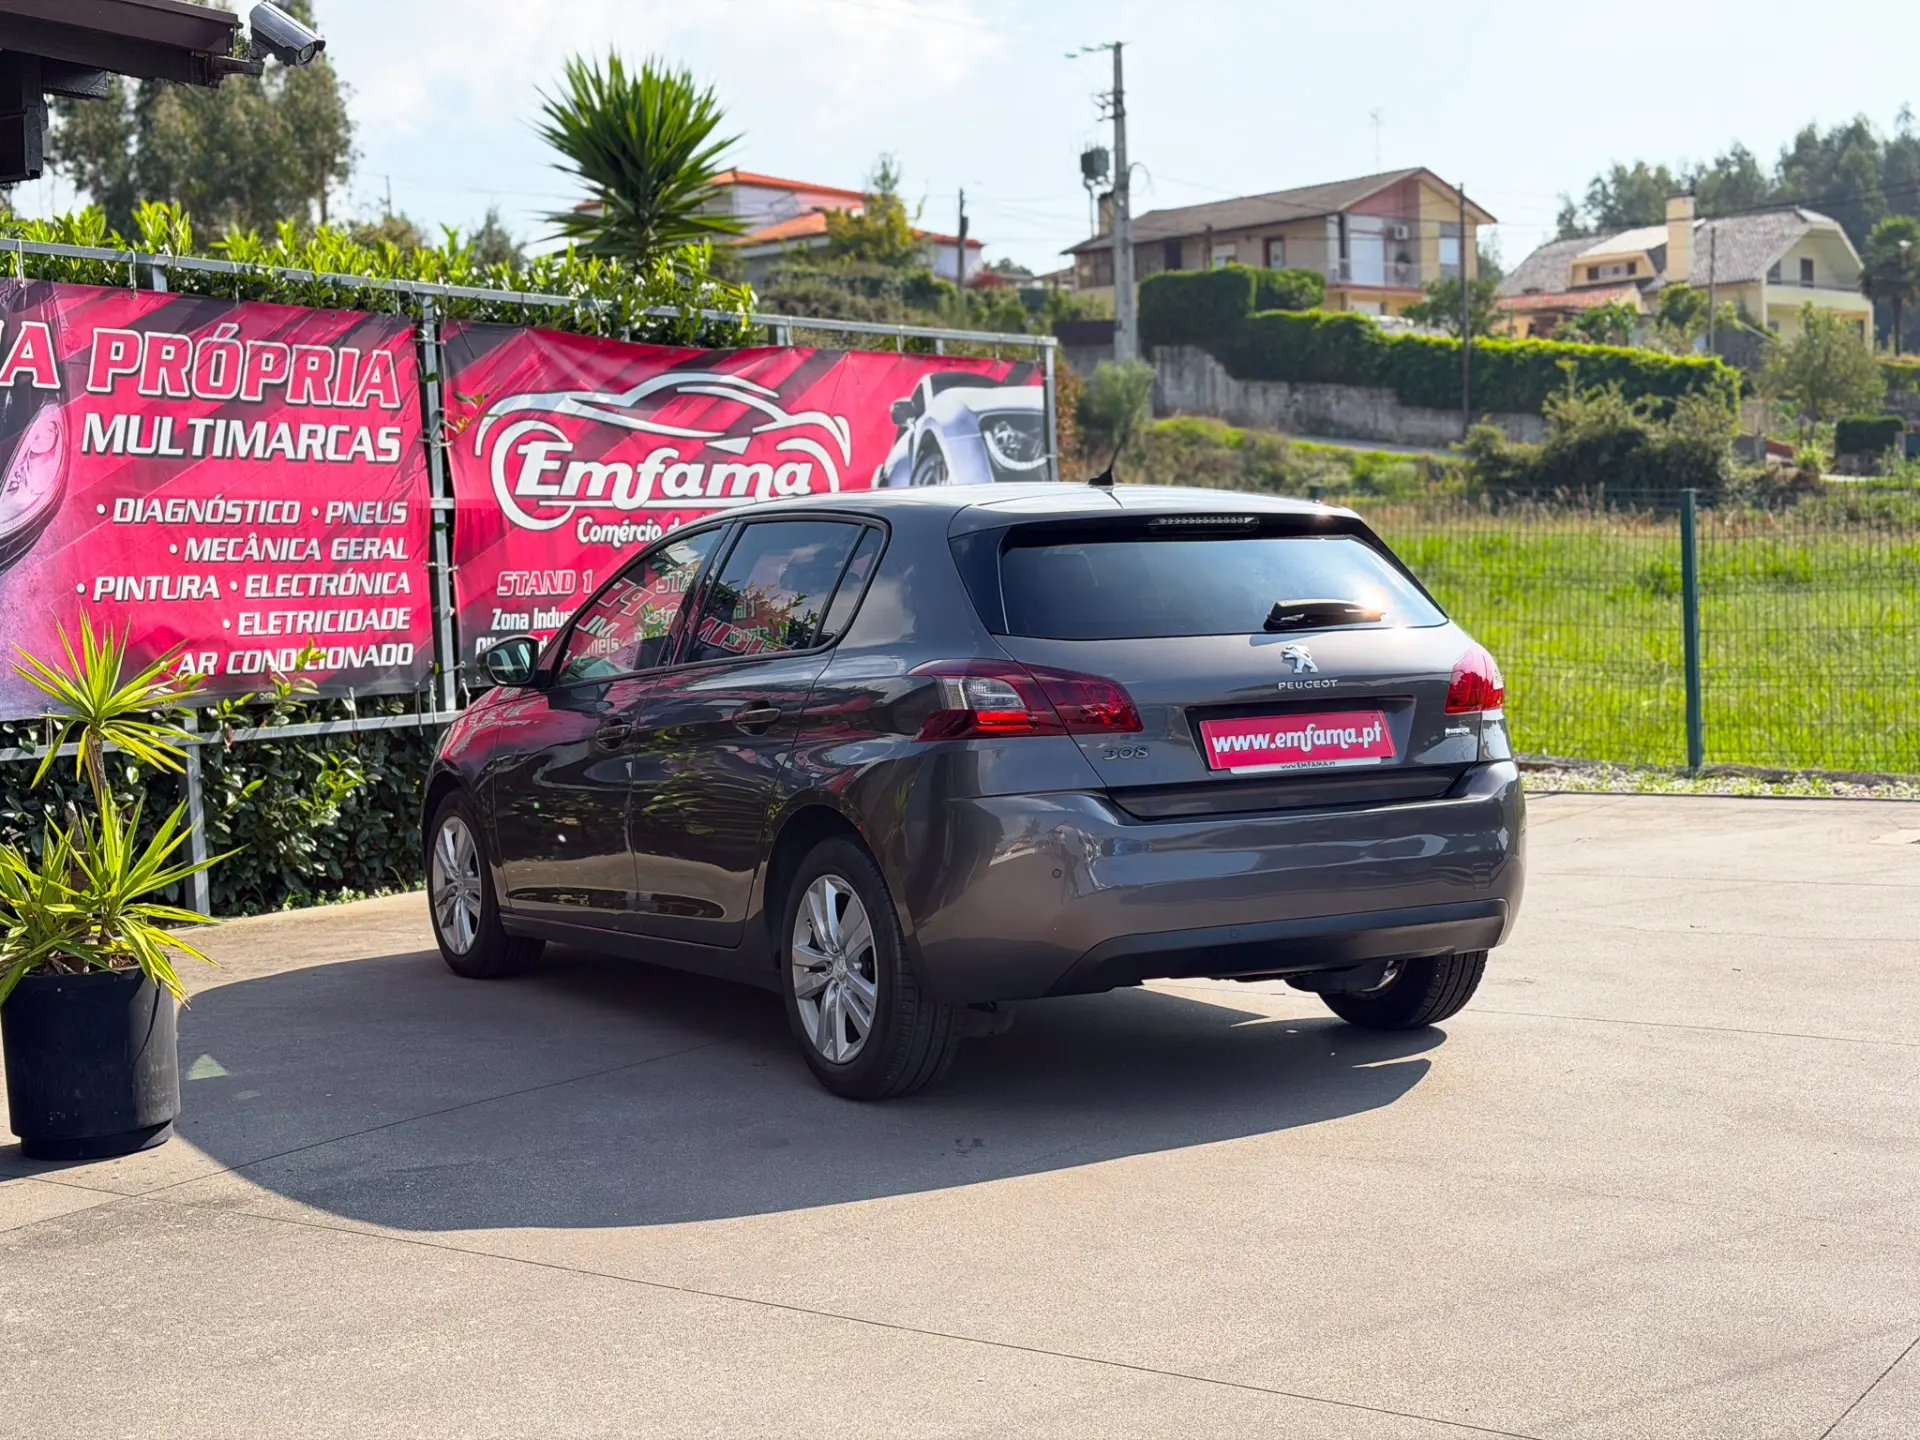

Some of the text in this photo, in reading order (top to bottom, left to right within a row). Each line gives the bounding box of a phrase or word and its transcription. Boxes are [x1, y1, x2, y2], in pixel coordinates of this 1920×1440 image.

[0, 319, 401, 408] A PRÓPRIA
[81, 413, 402, 462] MULTIMARCAS
[514, 440, 813, 511] Emfama
[113, 494, 408, 524] DIAGNÓSTICO PNEUS
[184, 532, 410, 562] MECÂNICA GERAL
[577, 516, 662, 548] Comércio
[93, 570, 411, 601] PINTURA ELECTRÓNICA
[497, 570, 594, 596] STAND 1
[238, 607, 412, 636] ELETRICIDADE
[491, 608, 530, 631] Zona
[176, 643, 414, 677] AR CONDCIONADO
[1278, 679, 1338, 690] PEUGEOT
[1212, 721, 1382, 752] www.emfama.pt
[1103, 746, 1149, 761] 308
